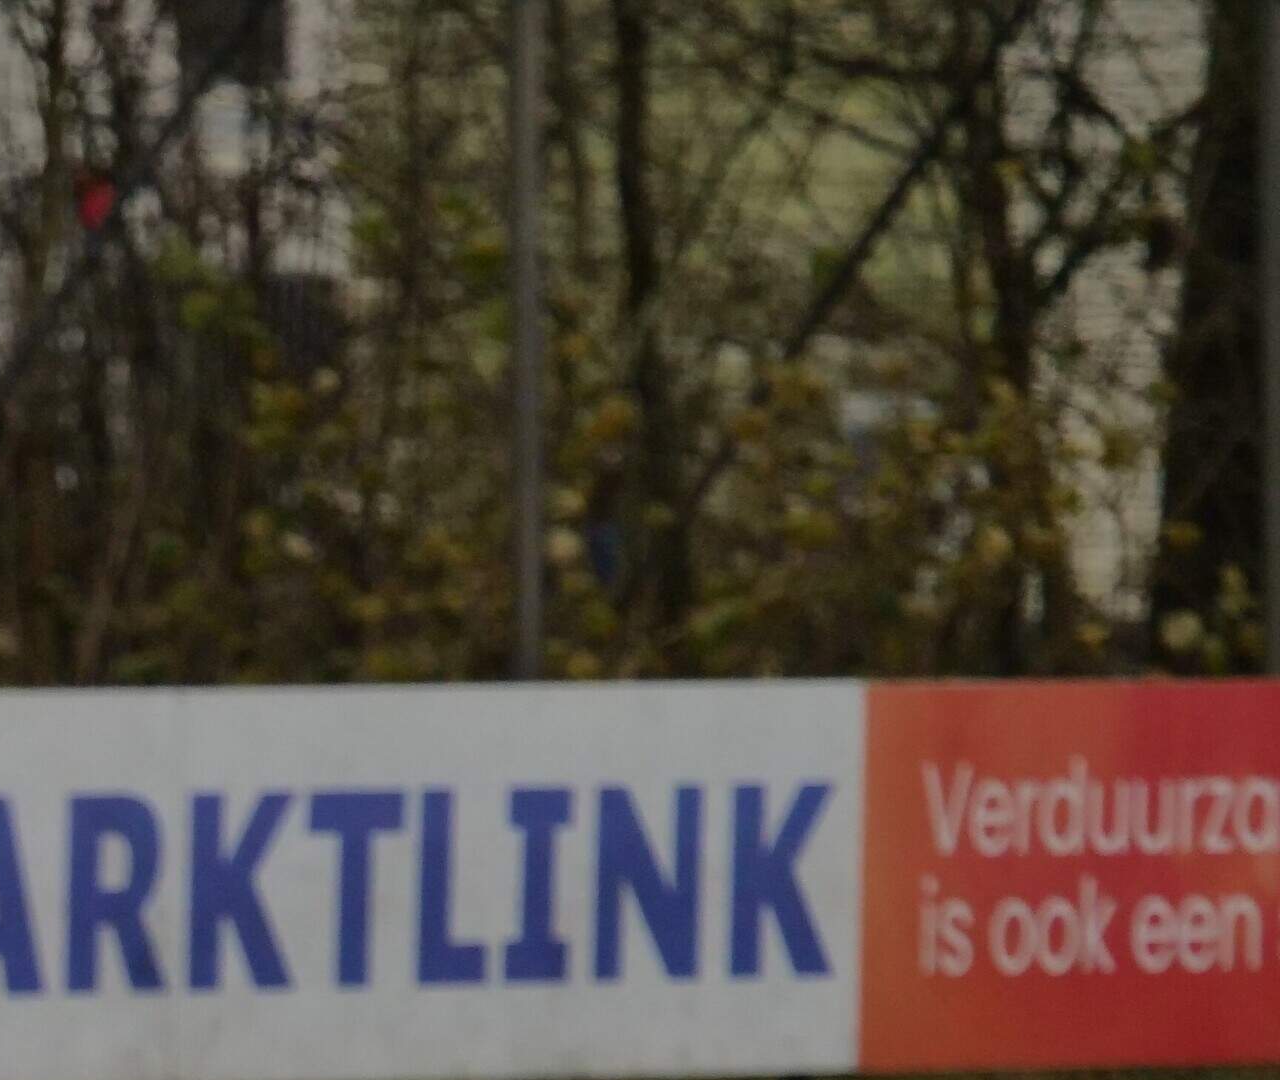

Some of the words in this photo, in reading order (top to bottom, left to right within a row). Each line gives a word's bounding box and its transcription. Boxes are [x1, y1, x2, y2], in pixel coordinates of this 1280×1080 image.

[917, 873, 976, 978] is
[989, 873, 1118, 977] ook
[1131, 891, 1263, 976] een
